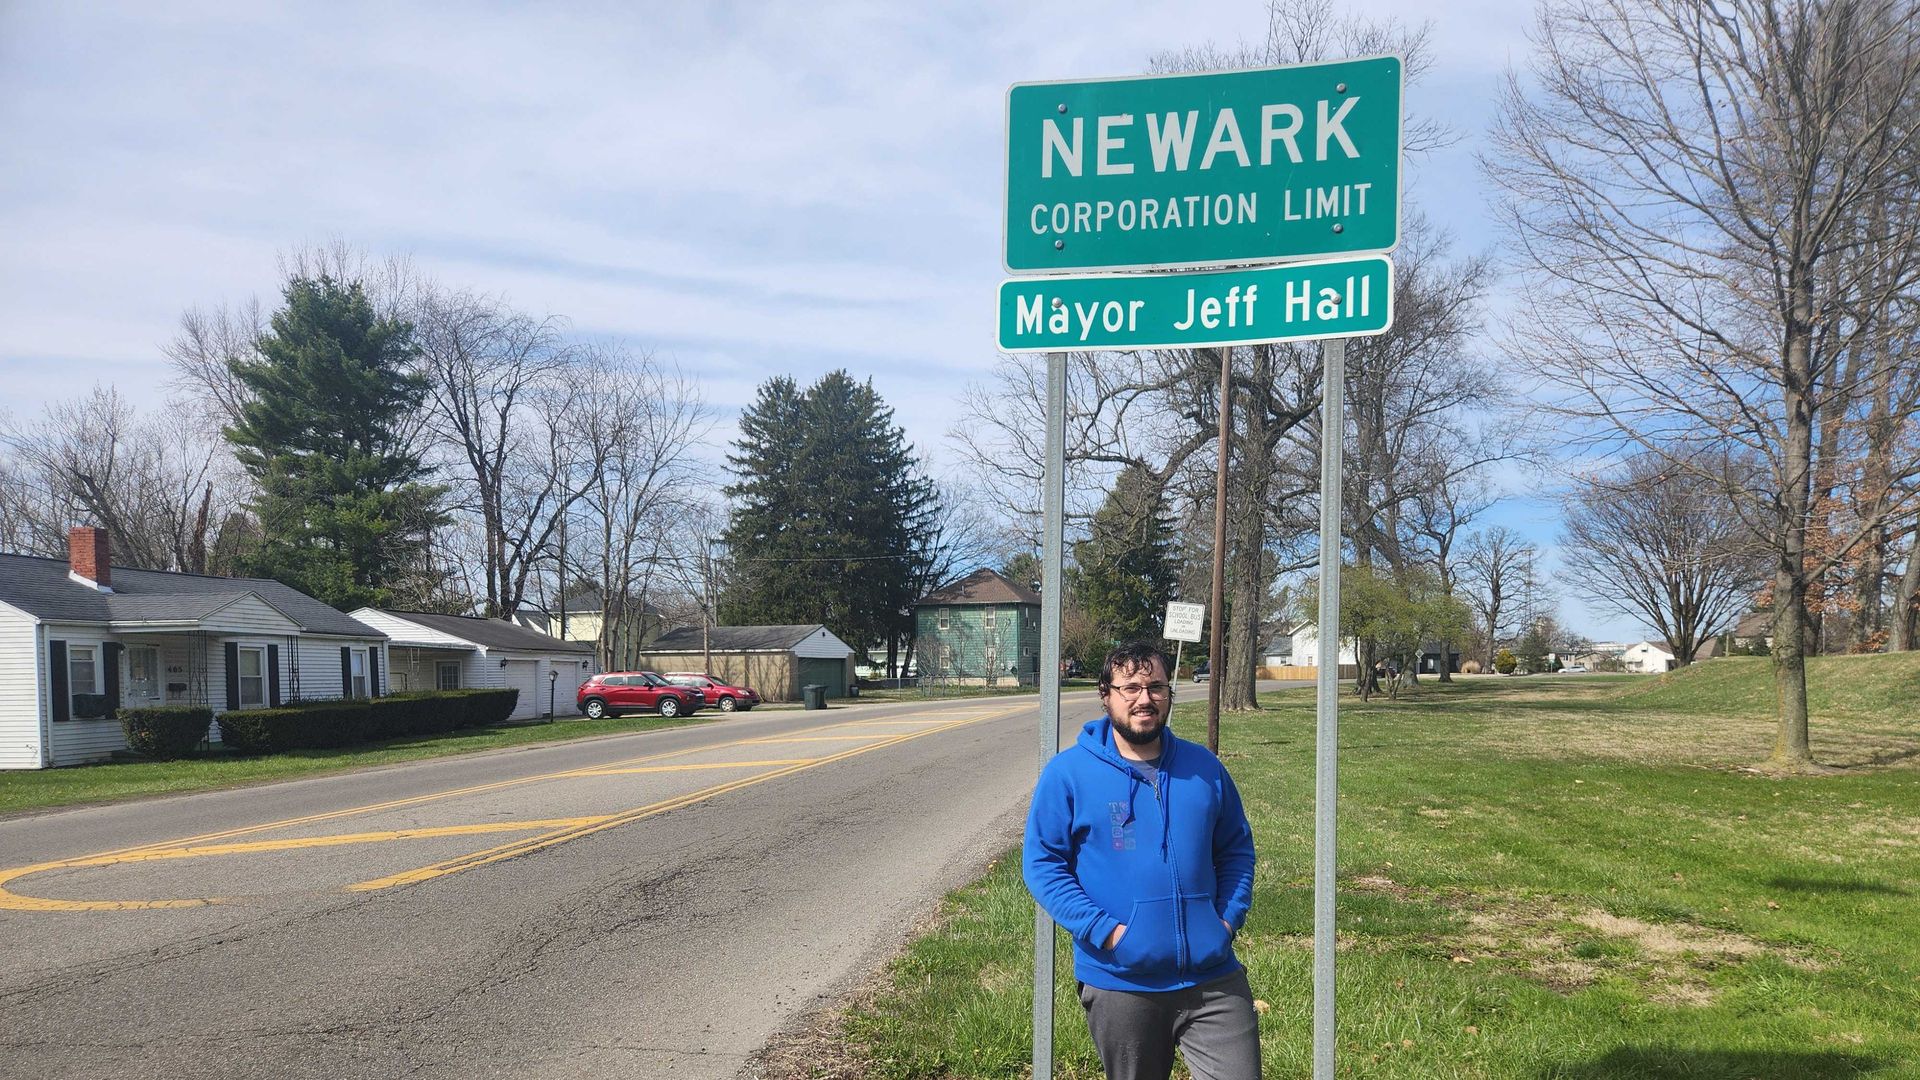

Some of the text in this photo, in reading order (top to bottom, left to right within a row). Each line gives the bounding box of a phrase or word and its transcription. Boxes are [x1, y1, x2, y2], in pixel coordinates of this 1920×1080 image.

[1041, 95, 1361, 179] NEWARK
[1030, 182, 1372, 235] CORPORATION LIMIT
[1015, 274, 1370, 341] Mayor Jeff Hall
[1169, 611, 1189, 619] SCHOOL
